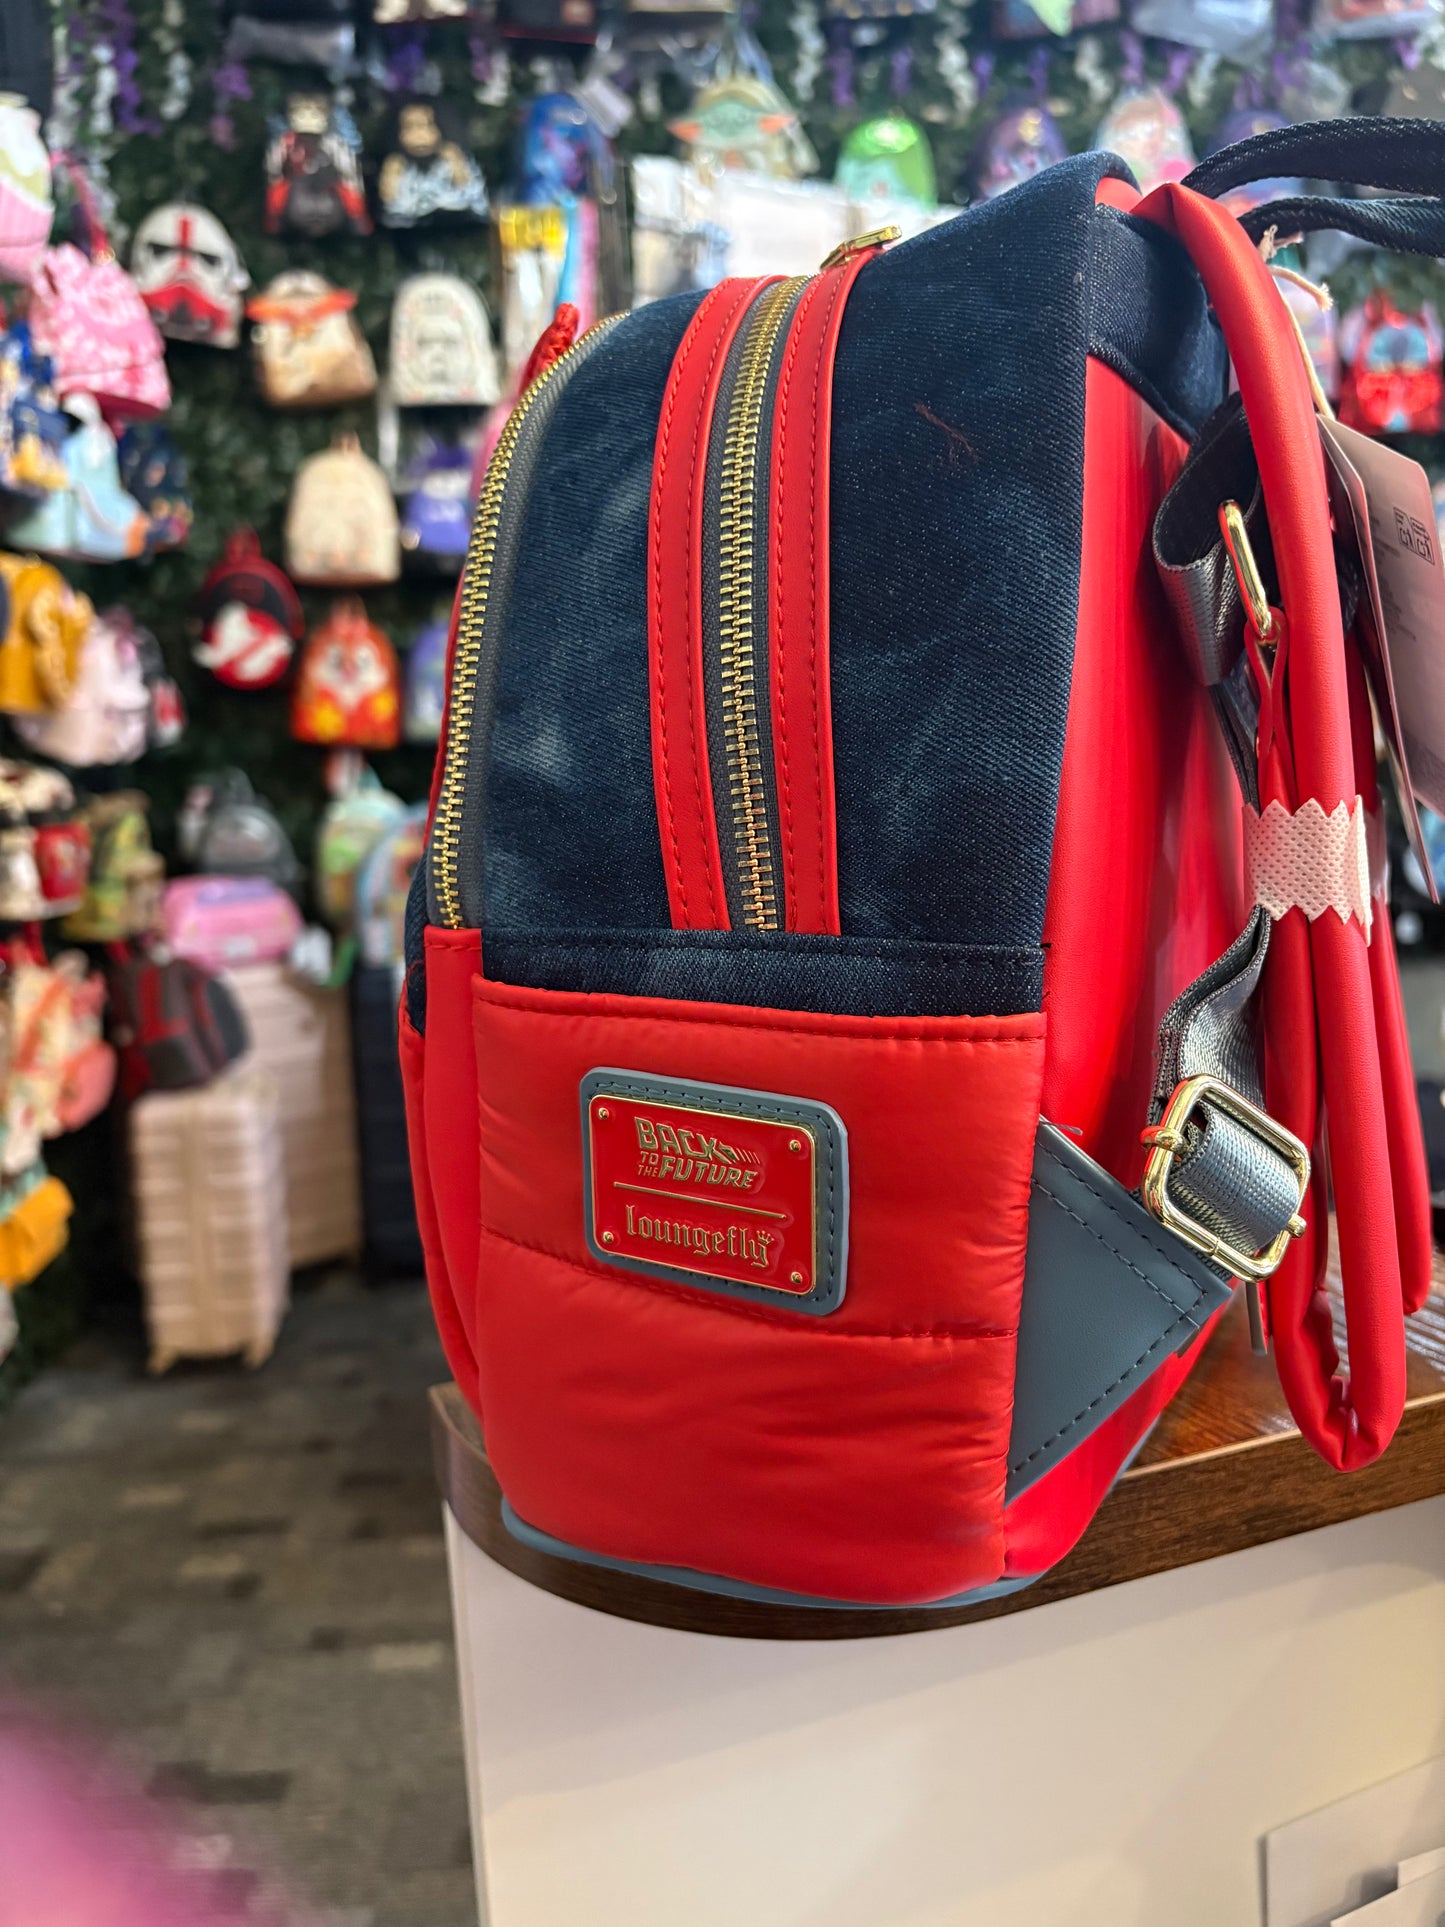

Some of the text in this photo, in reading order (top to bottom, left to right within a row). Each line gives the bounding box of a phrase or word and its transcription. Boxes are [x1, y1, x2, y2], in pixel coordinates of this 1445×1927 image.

[634, 1117, 733, 1164] BACK
[638, 1155, 758, 1189] THE FUTURE
[640, 1151, 659, 1166] TO
